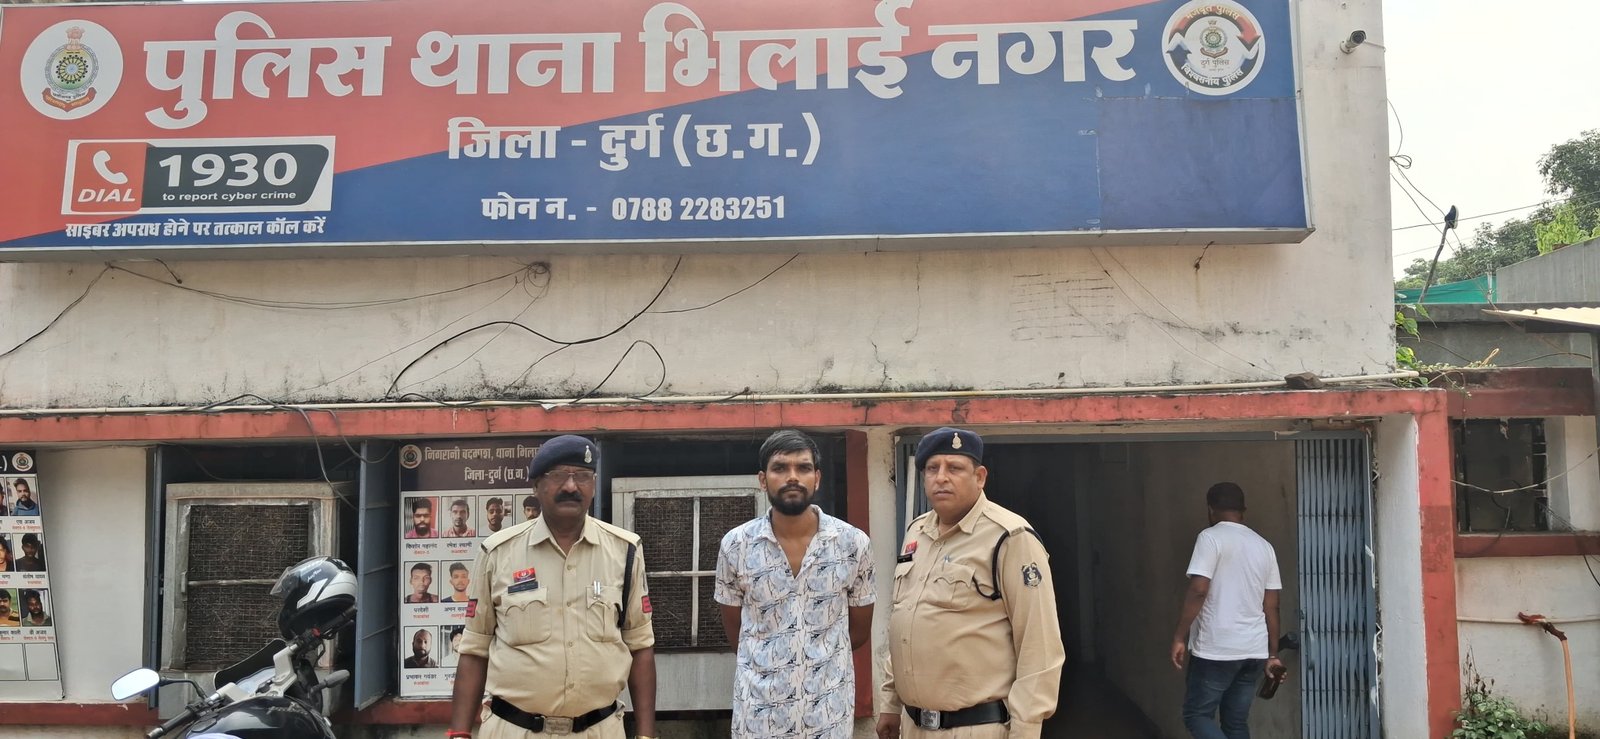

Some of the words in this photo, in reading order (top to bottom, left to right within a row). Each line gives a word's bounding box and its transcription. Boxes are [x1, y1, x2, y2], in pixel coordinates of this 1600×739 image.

[1216, 5, 1240, 20] पुलिस
[144, 11, 391, 128] पुलिस
[410, 31, 620, 94] थाना
[638, 0, 913, 98] भिलाई
[928, 20, 1138, 85] नगर
[1222, 69, 1244, 87] पुलिस
[447, 116, 561, 159] जिला
[599, 113, 666, 171] दुर्ग
[673, 113, 821, 167] (छ.ग.)
[159, 152, 297, 188] 1930
[77, 188, 136, 203] DIAL
[162, 192, 175, 201] to
[179, 192, 218, 202] report
[221, 191, 258, 201] cyber
[261, 190, 296, 200] crime
[481, 192, 540, 220] फोन
[544, 197, 577, 221] न.
[611, 196, 672, 221] 0788
[680, 195, 785, 221] 2283251
[65, 222, 109, 239] साइबर
[112, 222, 160, 238] अपराध
[163, 218, 190, 236] होने
[193, 221, 211, 236] पर
[213, 220, 262, 235] तत्काल
[266, 216, 299, 235] कॉल
[302, 215, 326, 234] करें
[425, 446, 460, 460] निगरानी
[496, 447, 515, 459] थाना
[517, 444, 543, 459] भिला
